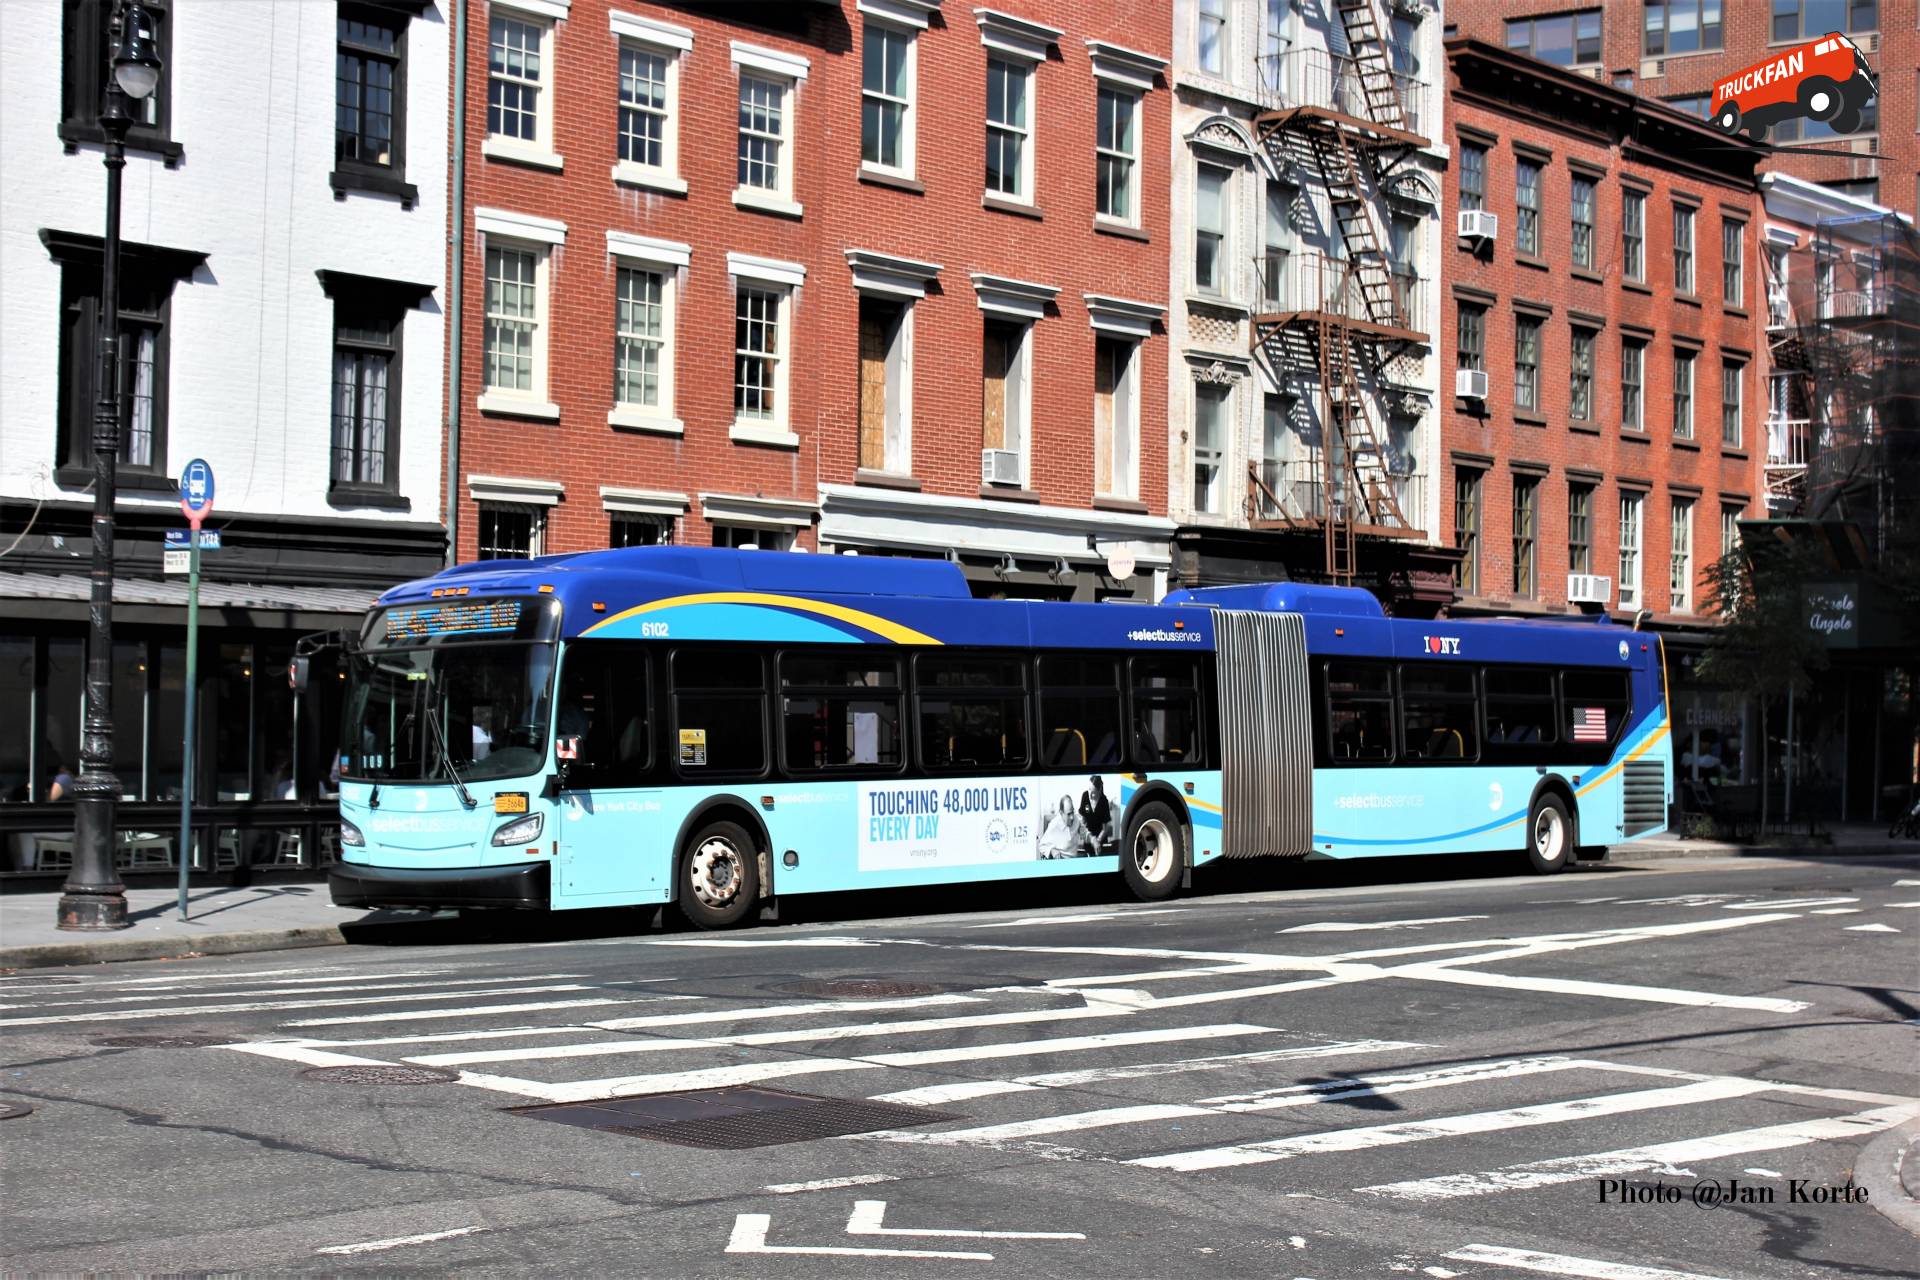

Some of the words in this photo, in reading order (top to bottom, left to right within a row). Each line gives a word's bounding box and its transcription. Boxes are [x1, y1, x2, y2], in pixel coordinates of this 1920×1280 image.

[641, 622, 670, 637] 6102
[1810, 614, 1852, 635] Angolo
[869, 789, 938, 816] TOUCHING
[943, 788, 989, 815] 48,000
[994, 786, 1028, 811] LIVES
[870, 815, 911, 842] EVERY
[915, 814, 940, 840] DAY
[1013, 825, 1029, 838] 125
